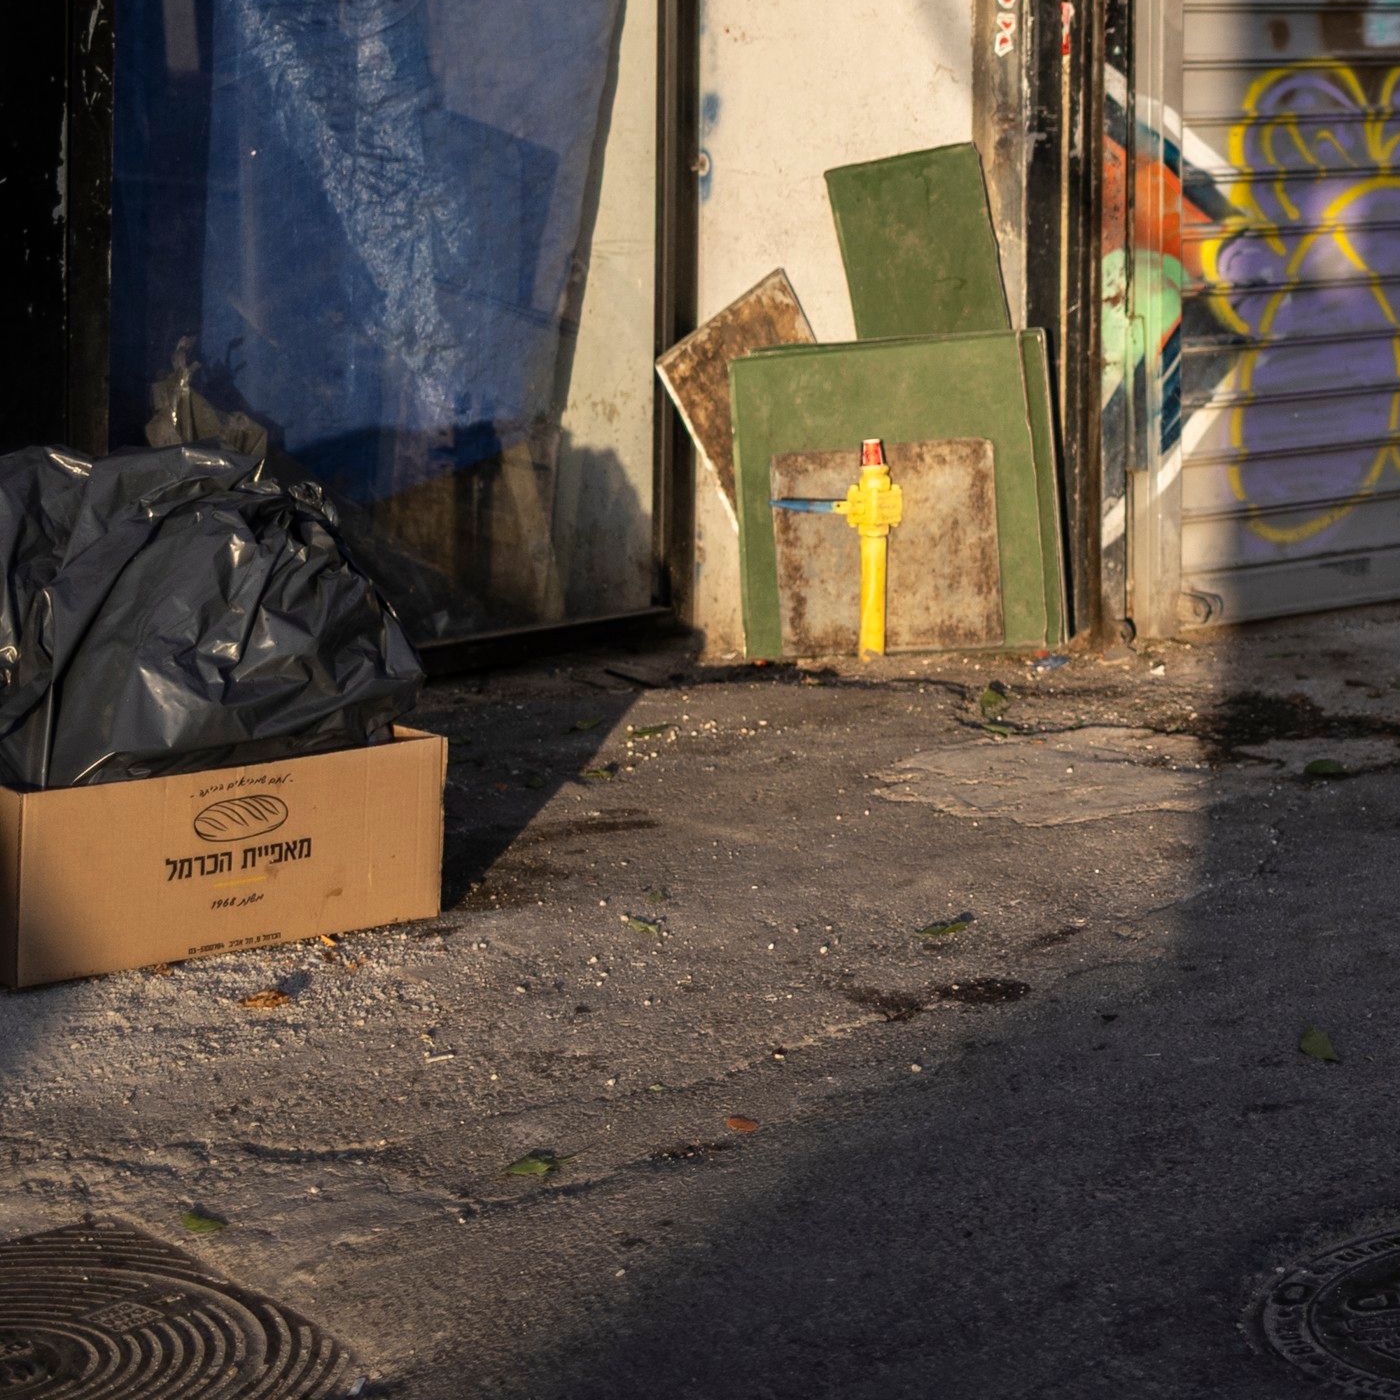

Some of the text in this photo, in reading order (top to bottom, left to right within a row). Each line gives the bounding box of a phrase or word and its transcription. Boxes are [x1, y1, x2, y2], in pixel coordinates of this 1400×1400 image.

[165, 837, 312, 882] מאפיית הכרמל
[211, 897, 237, 910] 1968
